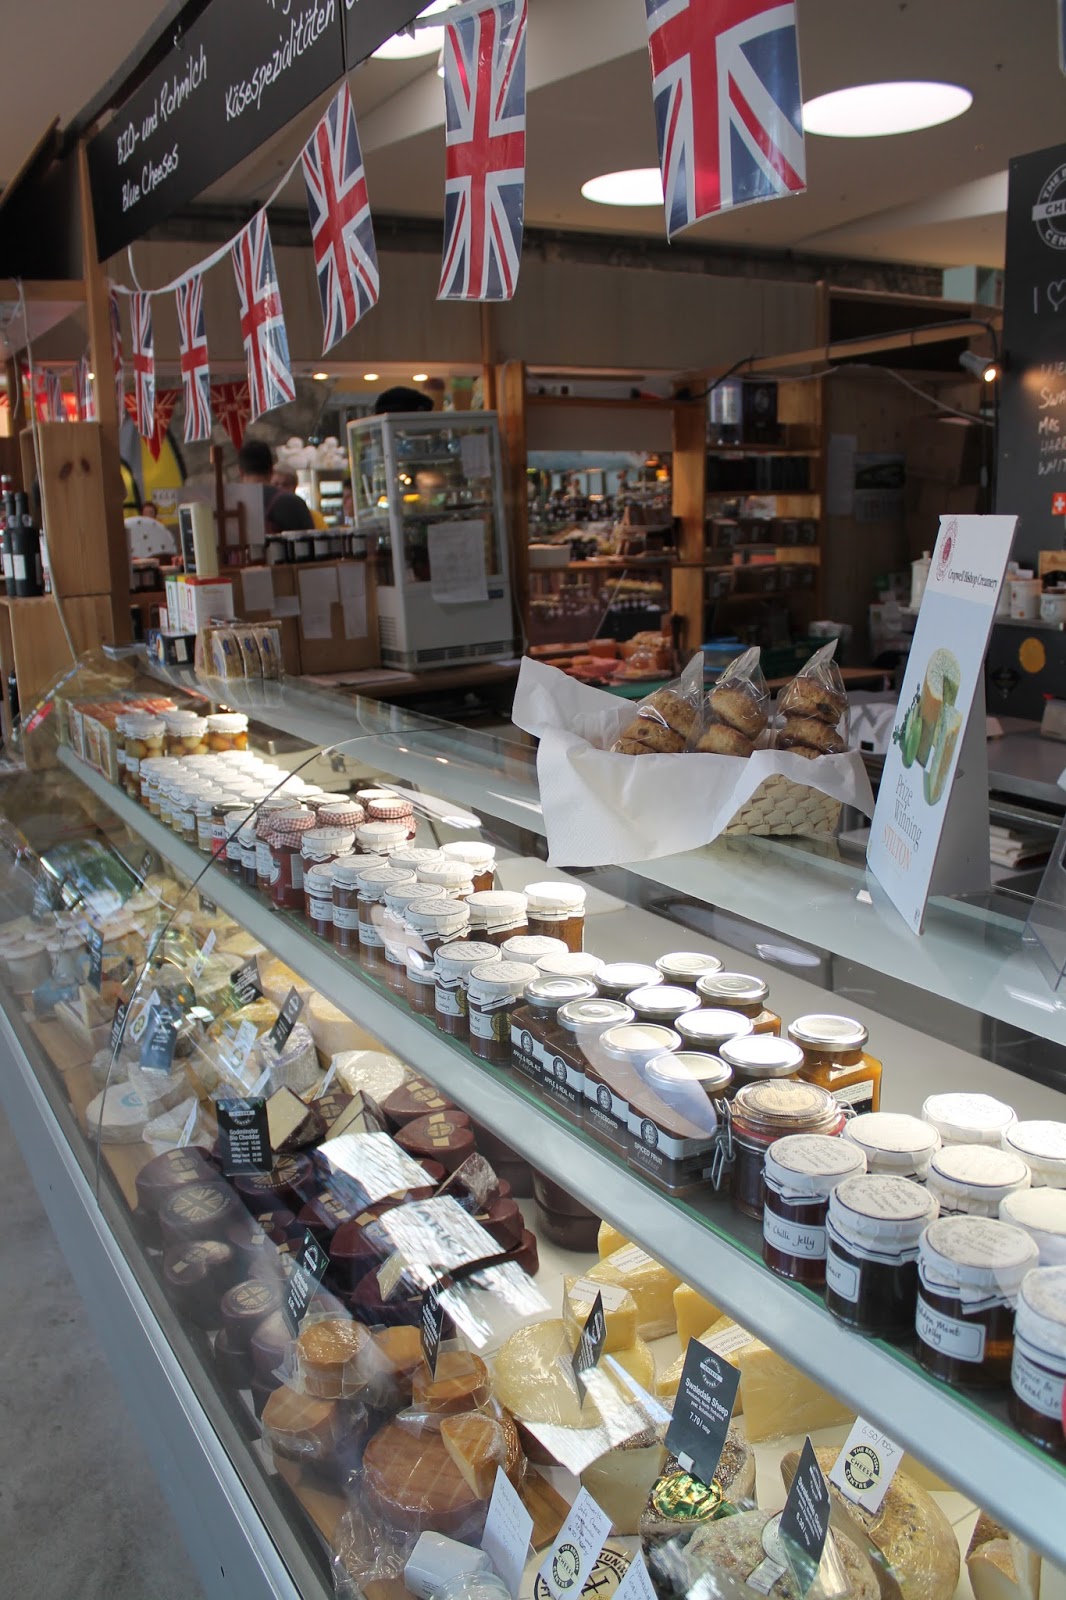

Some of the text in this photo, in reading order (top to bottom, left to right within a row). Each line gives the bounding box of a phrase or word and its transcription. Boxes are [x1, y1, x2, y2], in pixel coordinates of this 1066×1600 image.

[225, 0, 336, 122] Käsespezialitäten
[118, 44, 207, 165] BIO- und Rohmilch
[122, 144, 178, 212] Blue Cheeses
[1042, 174, 1060, 199] THE
[896, 774, 914, 810] Prize
[894, 798, 922, 852] Winning
[882, 824, 911, 872] STILTON
[590, 1106, 618, 1130] CHEESEBOARD
[634, 1142, 663, 1166] SPICED FRUIT
[792, 1234, 815, 1251] Jelly
[685, 1378, 728, 1417] Swaledale Sheep
[851, 1458, 873, 1478] CHEESE
[865, 1447, 879, 1470] BRITISH
[846, 1469, 867, 1488] CENTRE
[558, 1555, 574, 1578] CHEESE
